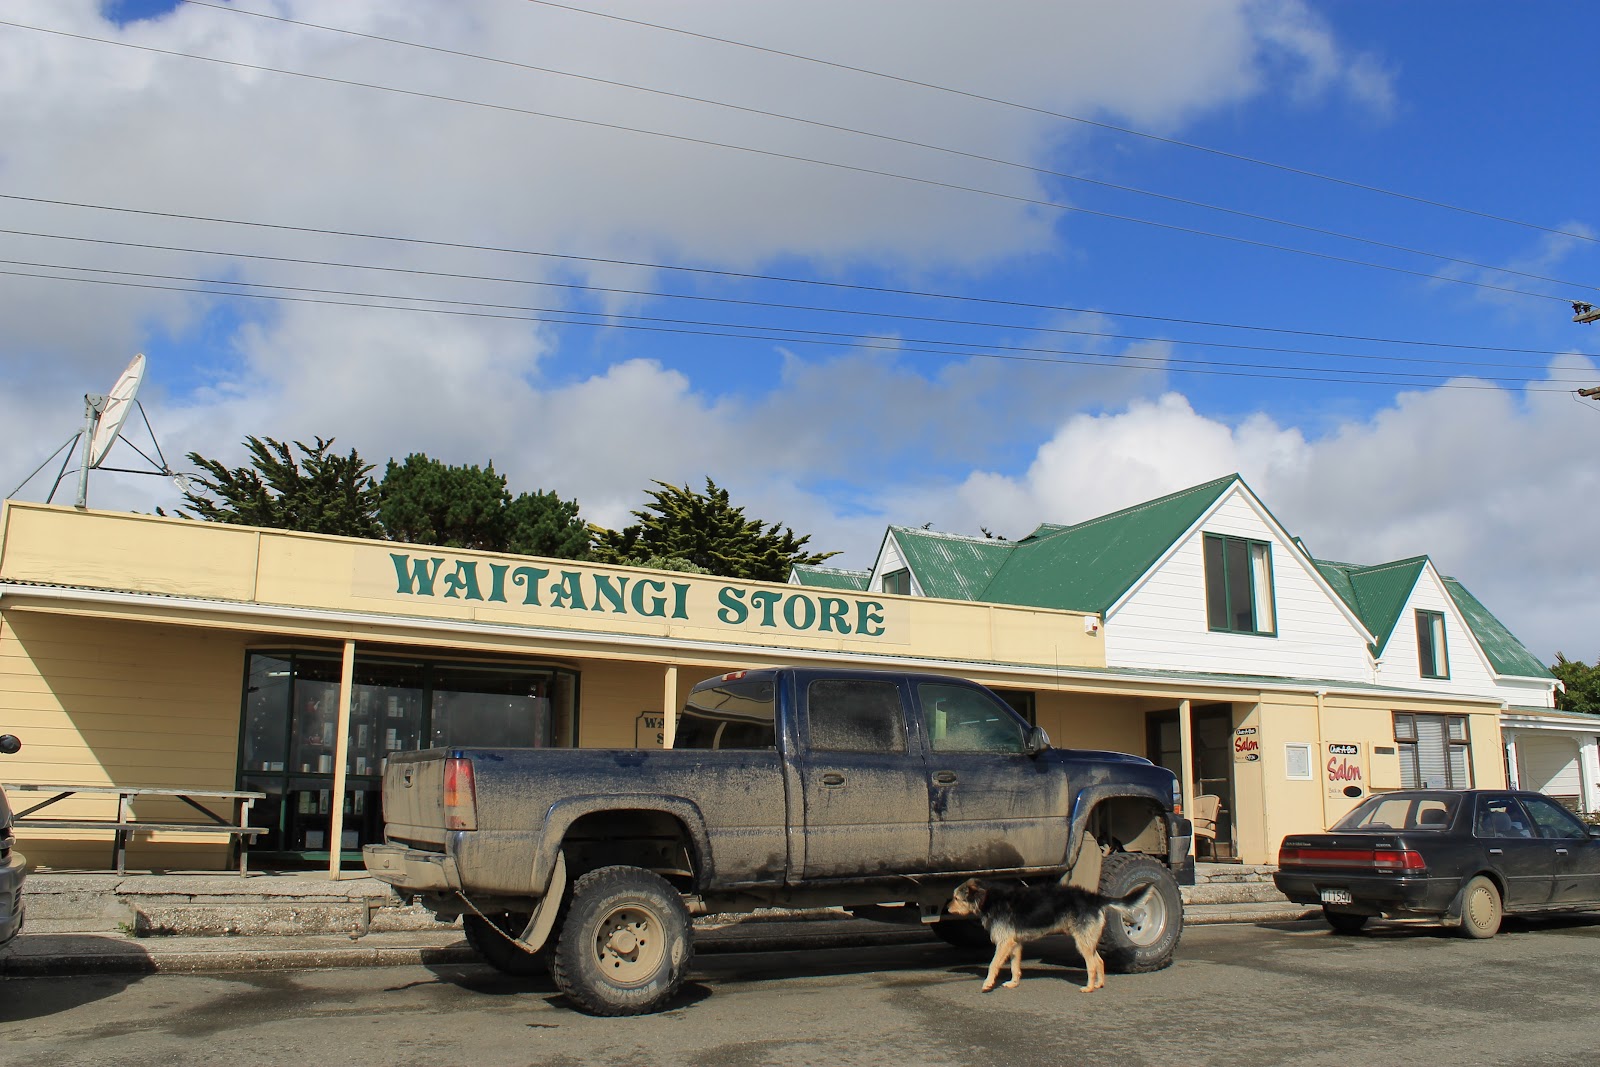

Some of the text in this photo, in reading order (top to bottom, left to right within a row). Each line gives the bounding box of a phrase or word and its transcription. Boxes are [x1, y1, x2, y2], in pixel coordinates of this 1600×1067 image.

[389, 552, 886, 638] WAITANGI STORE
[1235, 737, 1258, 752] Salon
[1327, 757, 1361, 781] Salon
